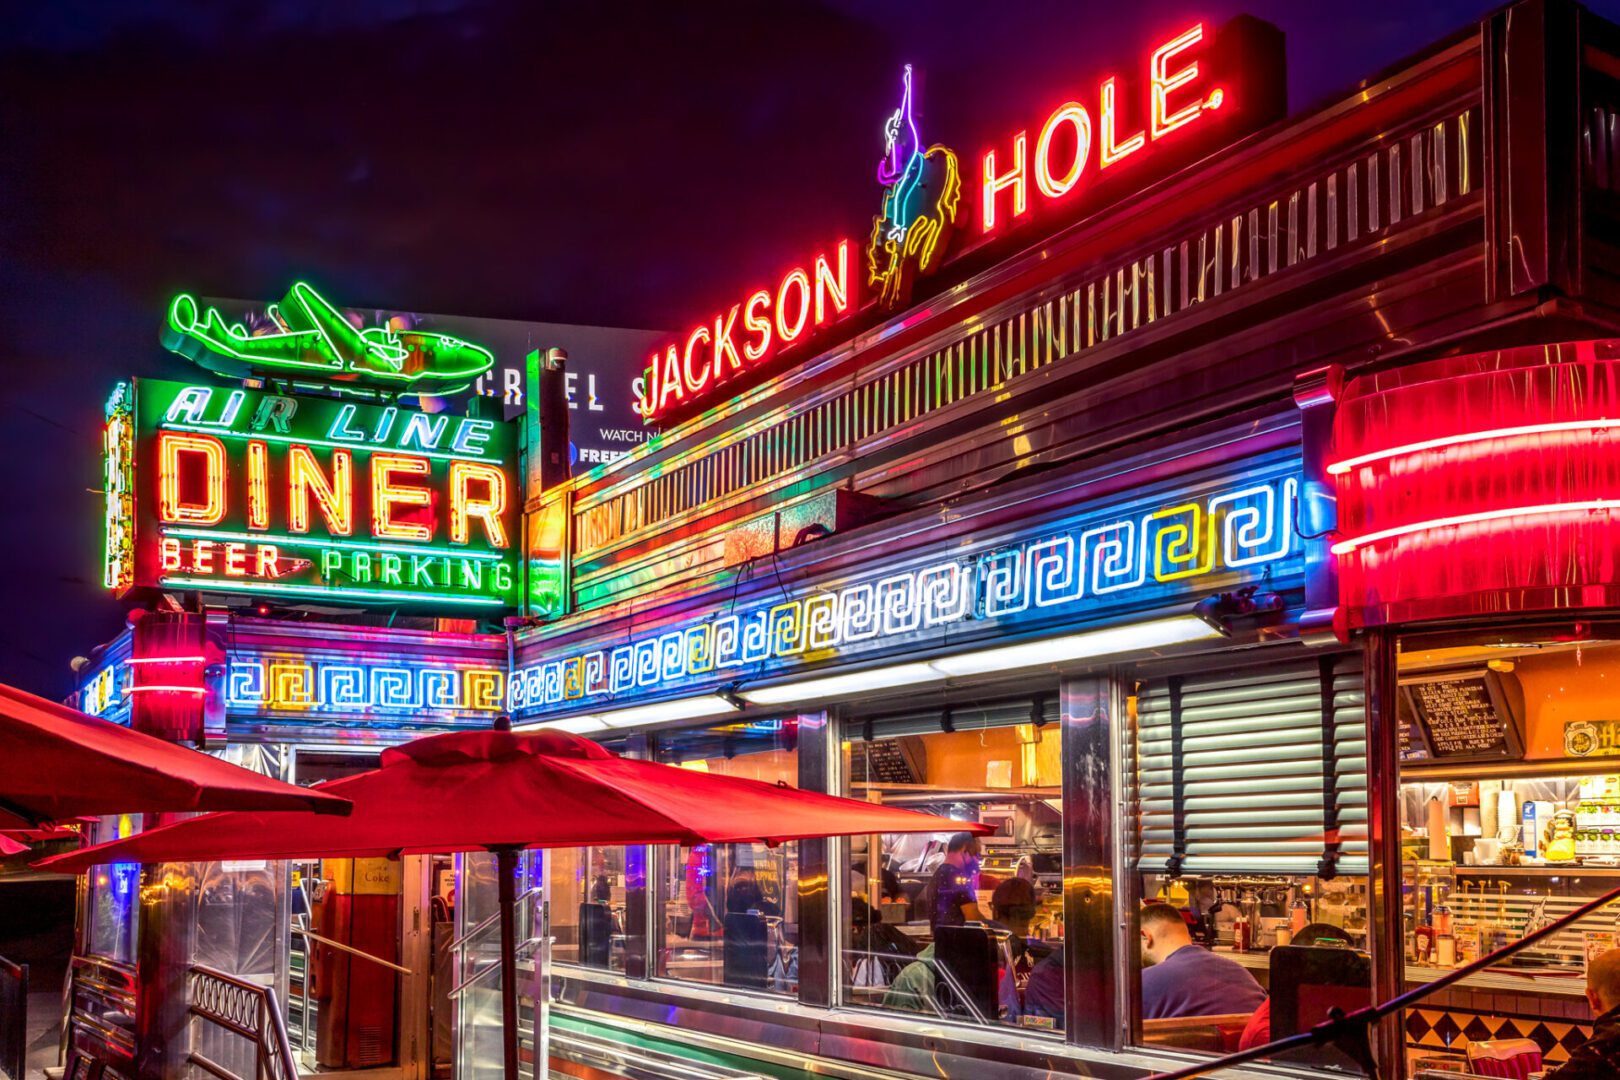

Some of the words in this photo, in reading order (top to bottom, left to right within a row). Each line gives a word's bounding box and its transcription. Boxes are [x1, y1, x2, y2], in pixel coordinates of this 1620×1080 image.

[641, 239, 849, 421] JACKSON
[476, 368, 604, 411] CREL
[165, 386, 298, 433] AIR
[327, 404, 495, 455] LINE
[600, 428, 643, 442] WATCH
[157, 430, 510, 548] DINER
[160, 538, 281, 578] BEER
[322, 549, 513, 592] PARKING
[365, 871, 391, 884] Coke
